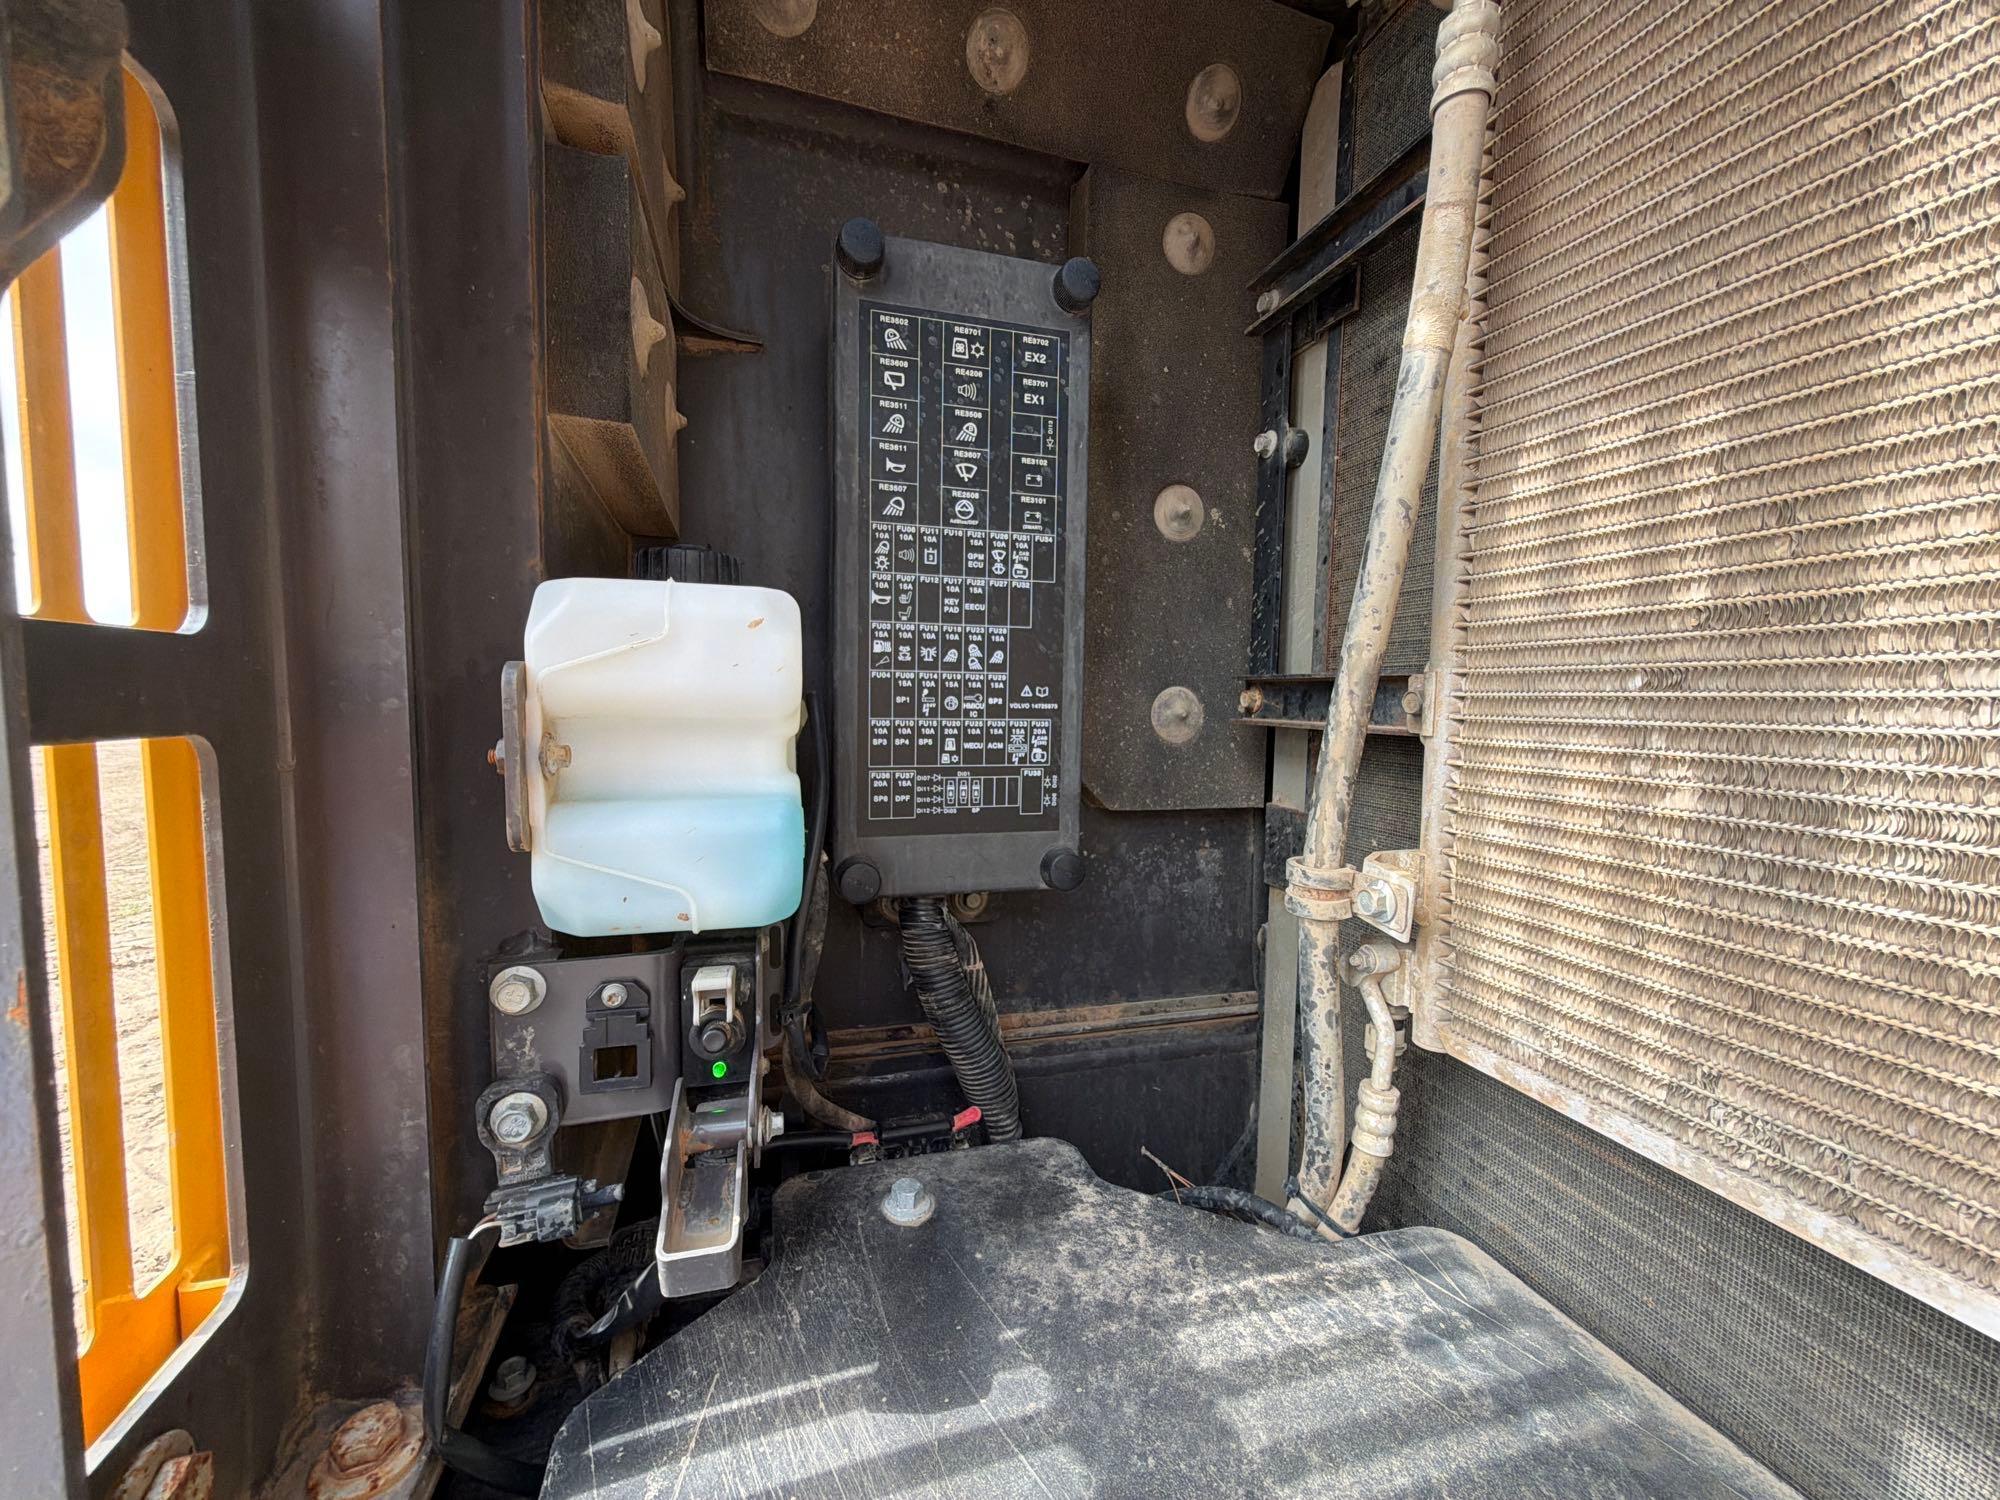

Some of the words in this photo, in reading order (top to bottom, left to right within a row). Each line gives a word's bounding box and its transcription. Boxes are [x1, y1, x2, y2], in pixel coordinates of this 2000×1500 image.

[1025, 352, 1046, 364] EX2
[1024, 394, 1044, 405] EX1
[1022, 458, 1048, 466] RE3102
[1021, 496, 1046, 504] RE3101
